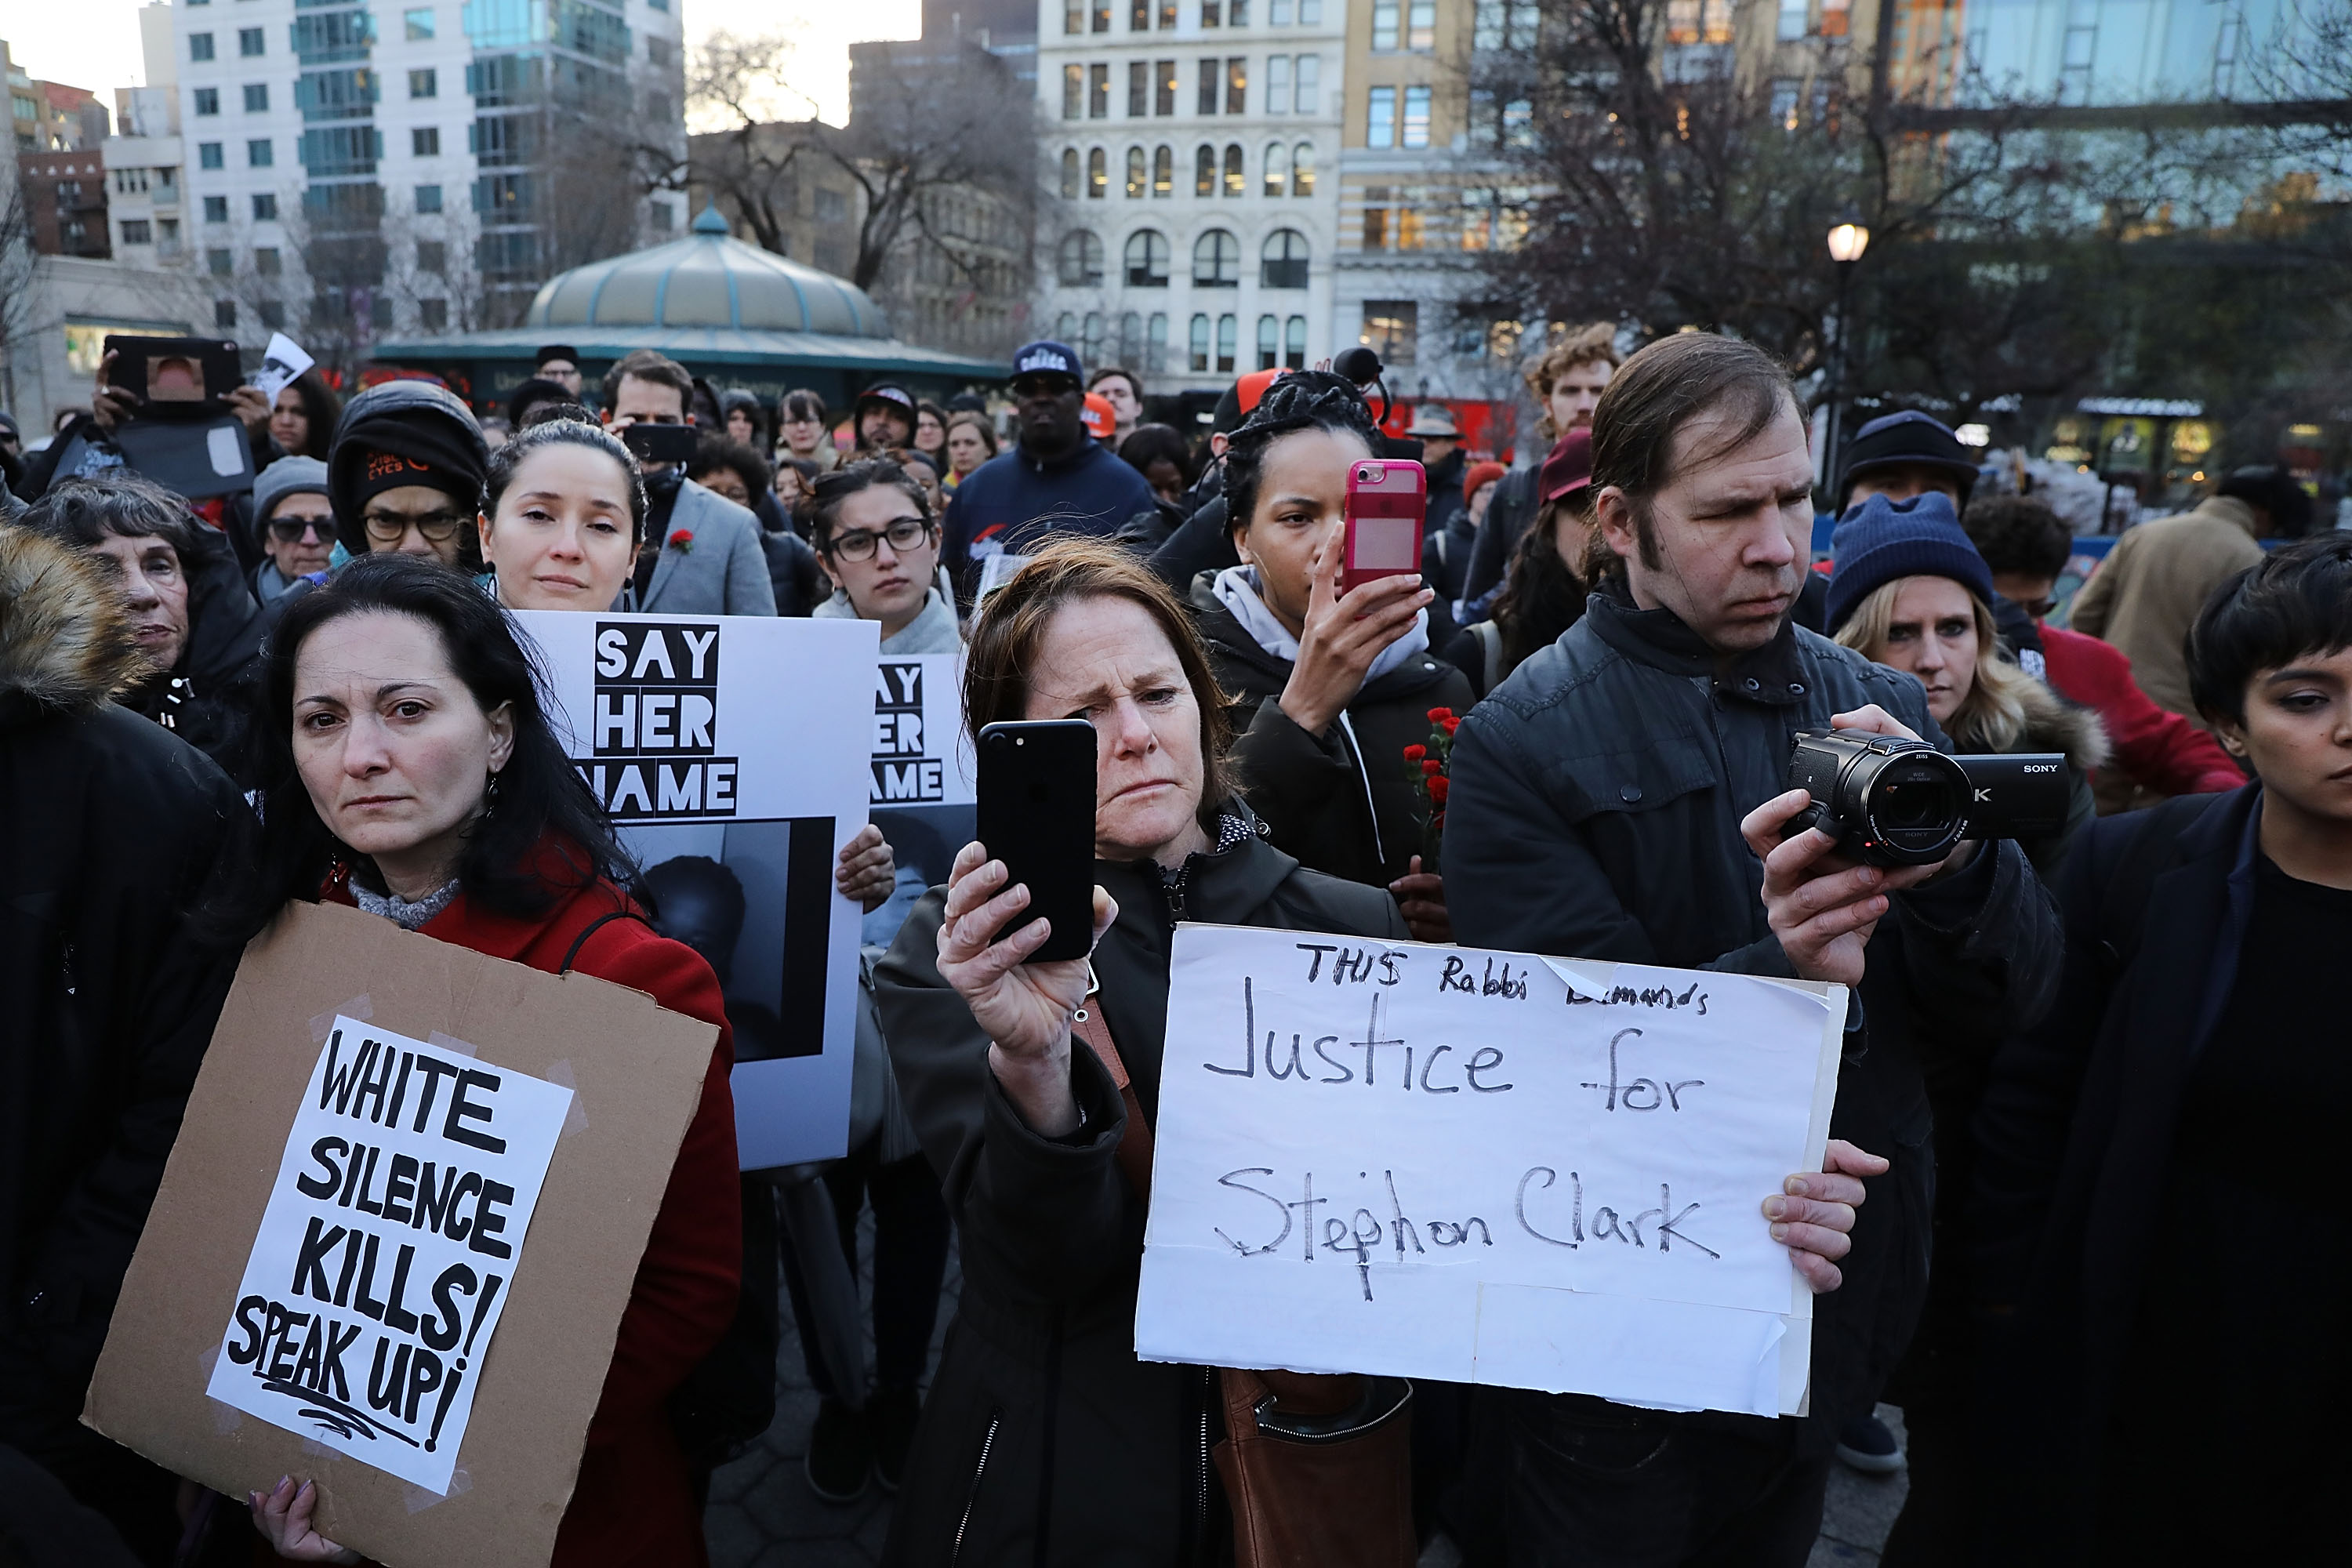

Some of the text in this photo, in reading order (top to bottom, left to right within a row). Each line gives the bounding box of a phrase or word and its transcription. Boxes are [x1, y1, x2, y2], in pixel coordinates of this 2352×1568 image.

[597, 629, 717, 679] SAY
[877, 666, 921, 704] AY
[595, 695, 713, 748] HER
[873, 713, 924, 753] ER
[869, 762, 942, 800] AME
[1974, 788, 1992, 802] K
[2024, 764, 2058, 773] SONY
[1297, 942, 1407, 986] THIS
[1439, 955, 1528, 1000] Rabbi
[1203, 977, 1705, 1112] Justice for
[319, 1029, 507, 1154] WHITE
[296, 1136, 515, 1260] SILENCE
[1214, 1166, 1720, 1302] Stephon Clark
[292, 1217, 503, 1371] KILLS!
[227, 1295, 463, 1452] SPEAK UP!
